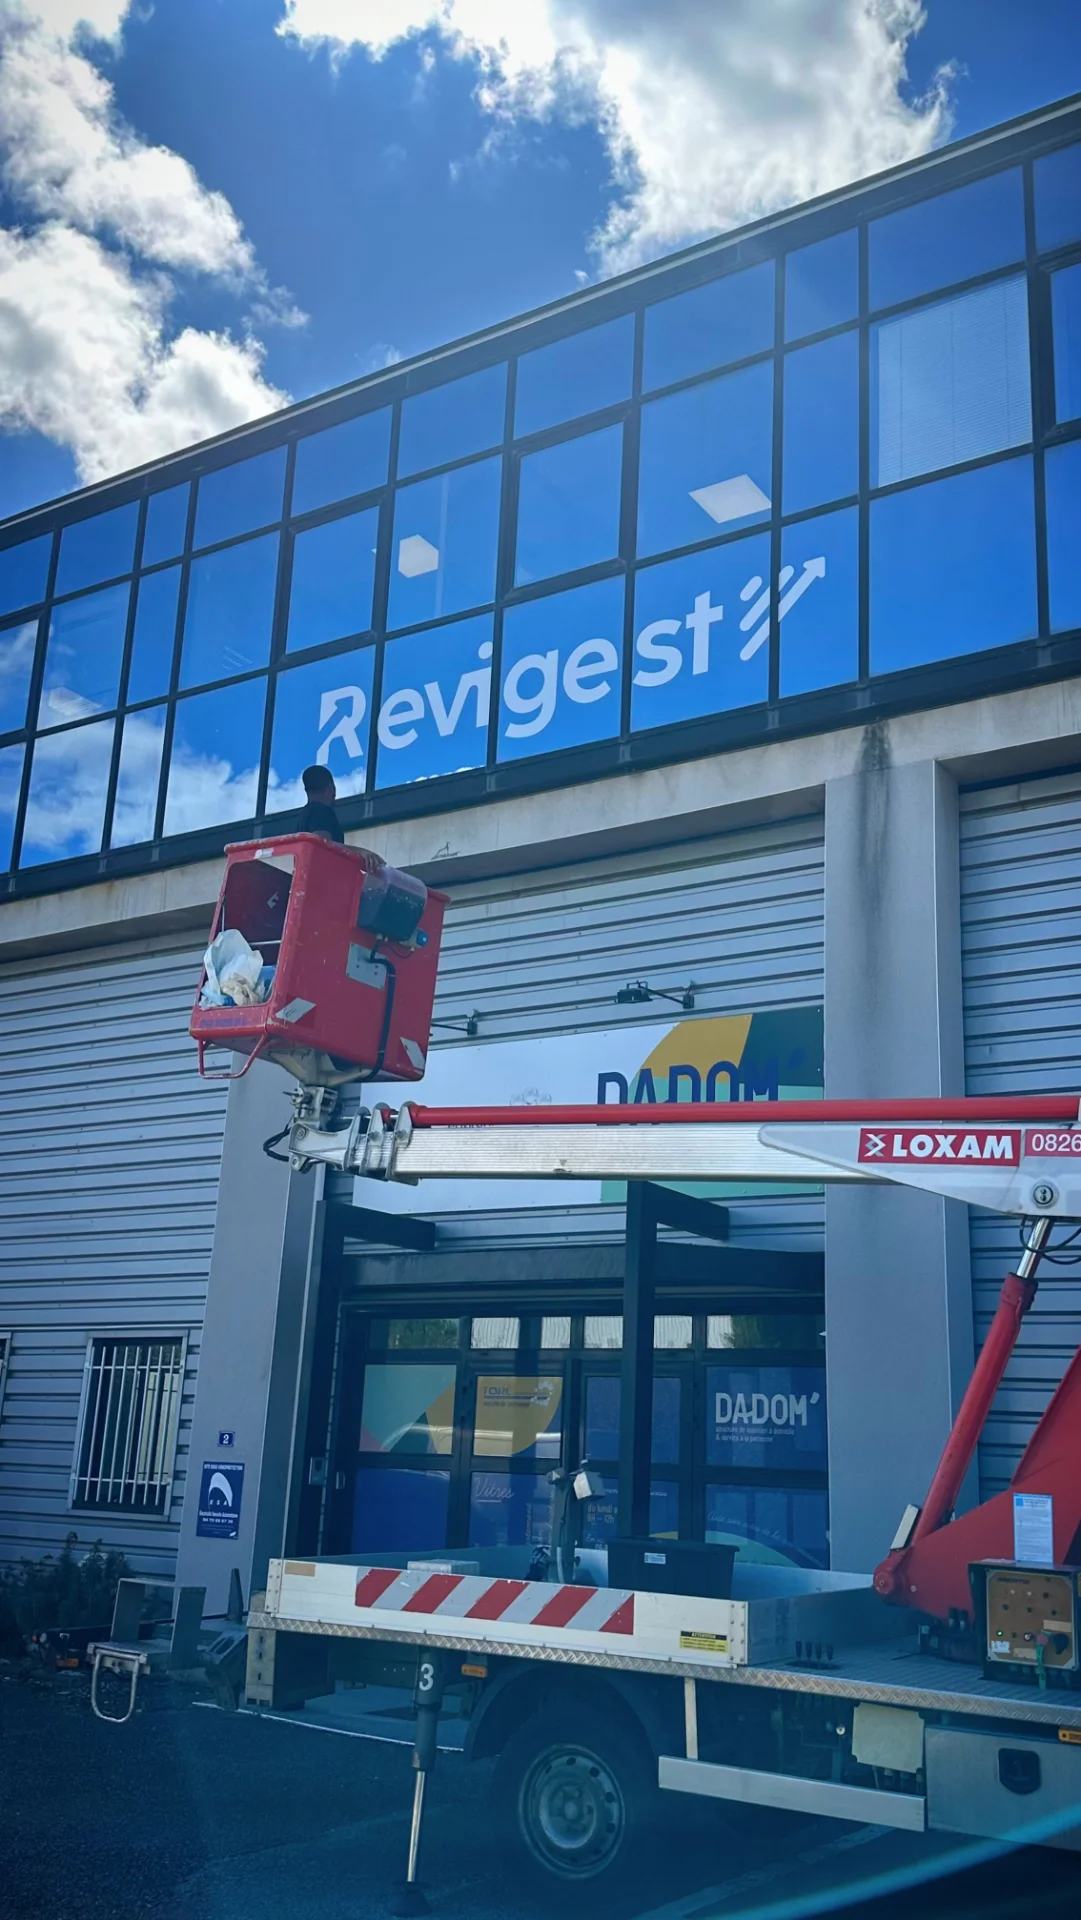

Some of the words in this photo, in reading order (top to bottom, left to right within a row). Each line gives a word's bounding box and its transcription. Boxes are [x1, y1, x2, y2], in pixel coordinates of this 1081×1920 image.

[316, 589, 724, 766] Revigest
[892, 1133, 1014, 1159] LOXAM
[1031, 1133, 1081, 1153] 0826
[222, 1434, 230, 1444] 2
[419, 1663, 434, 1691] 3
